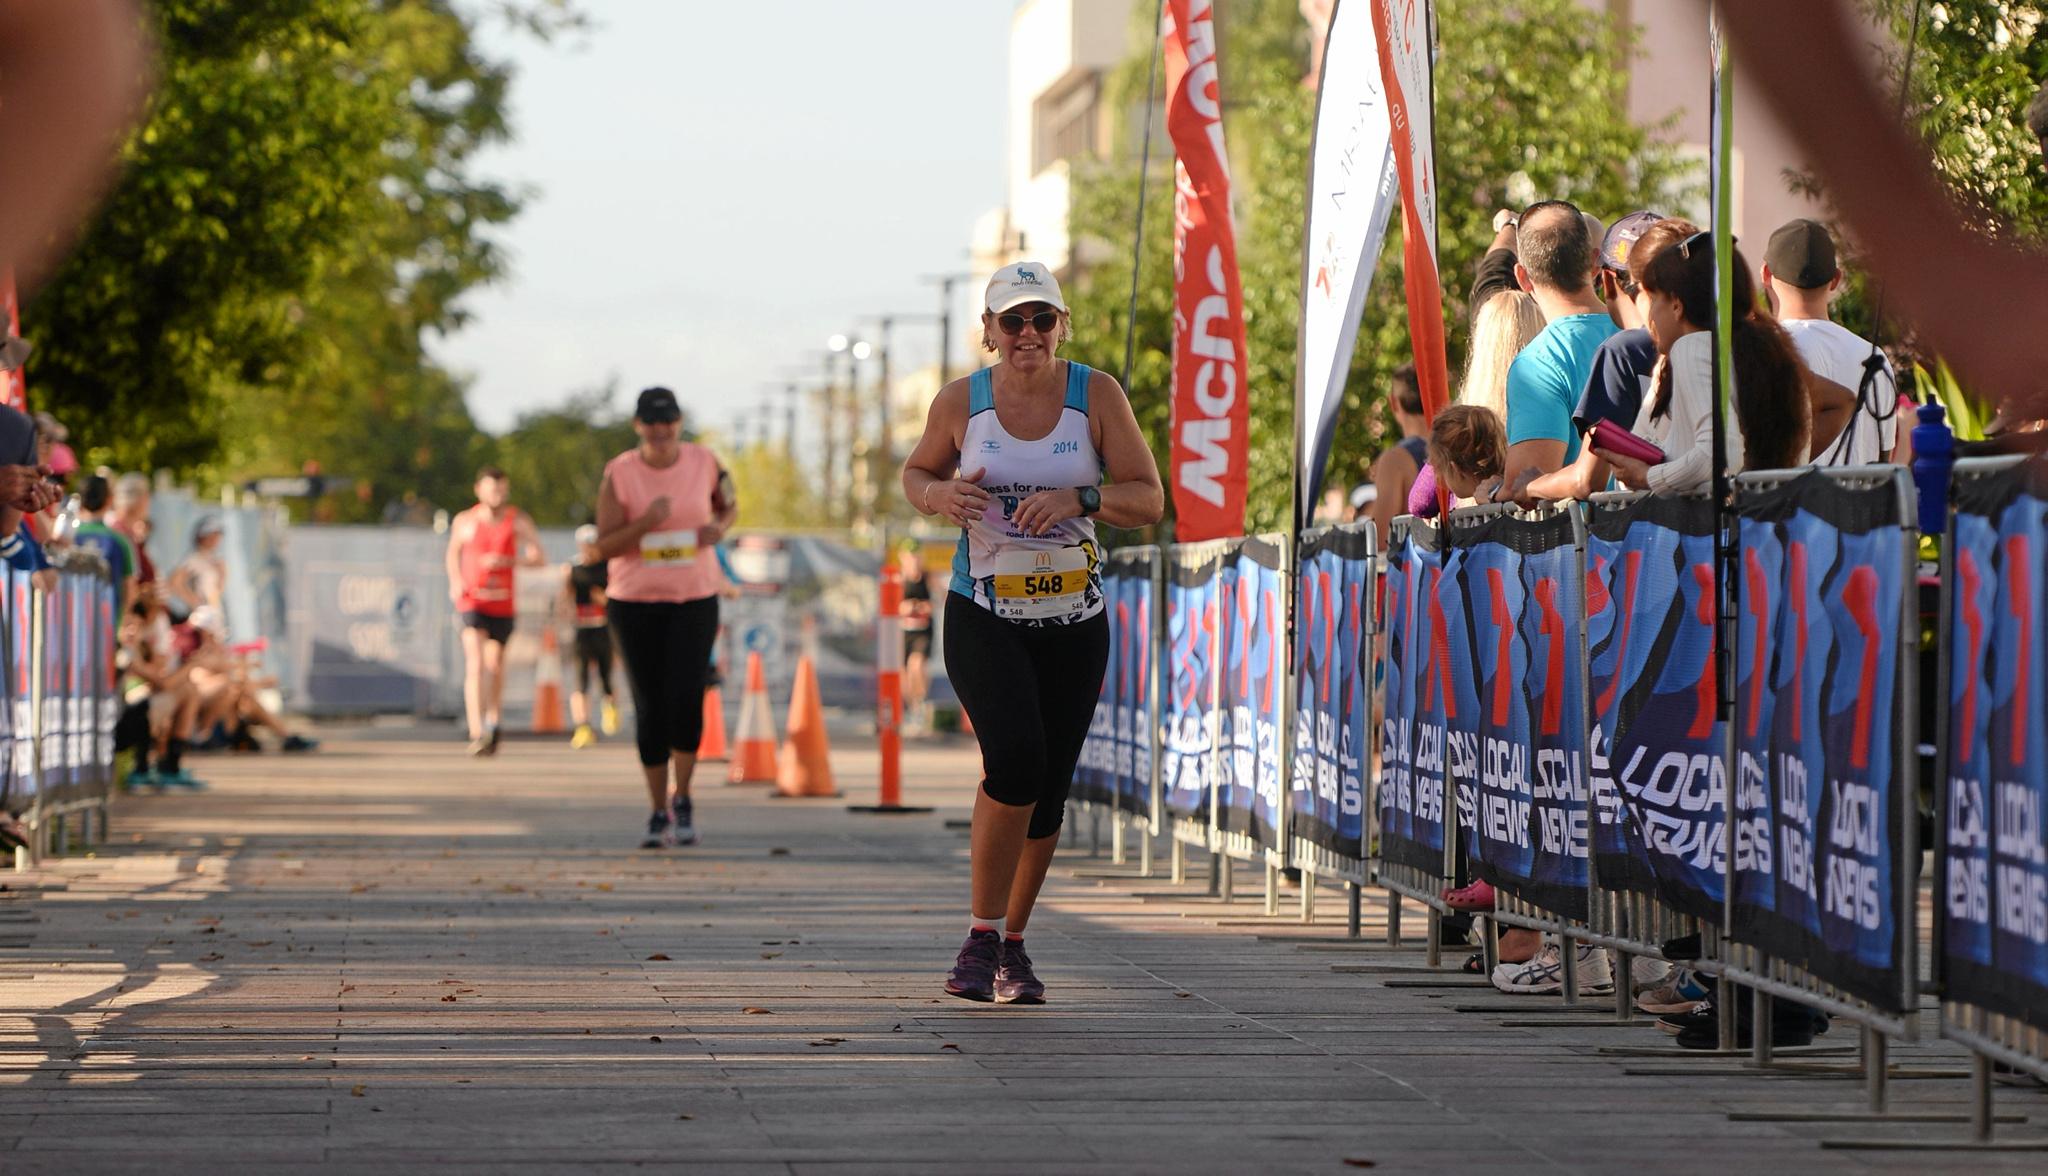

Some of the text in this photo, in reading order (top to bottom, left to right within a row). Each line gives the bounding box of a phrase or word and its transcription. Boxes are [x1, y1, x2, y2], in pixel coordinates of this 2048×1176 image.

[1052, 441, 1078, 454] 2014
[1013, 483, 1032, 493] for
[1006, 531, 1024, 539] road
[1024, 574, 1063, 595] 548
[1009, 608, 1024, 616] 548
[1072, 602, 1084, 611] 548
[1483, 735, 1531, 795] LOCAL
[1482, 792, 1531, 849] NEWS
